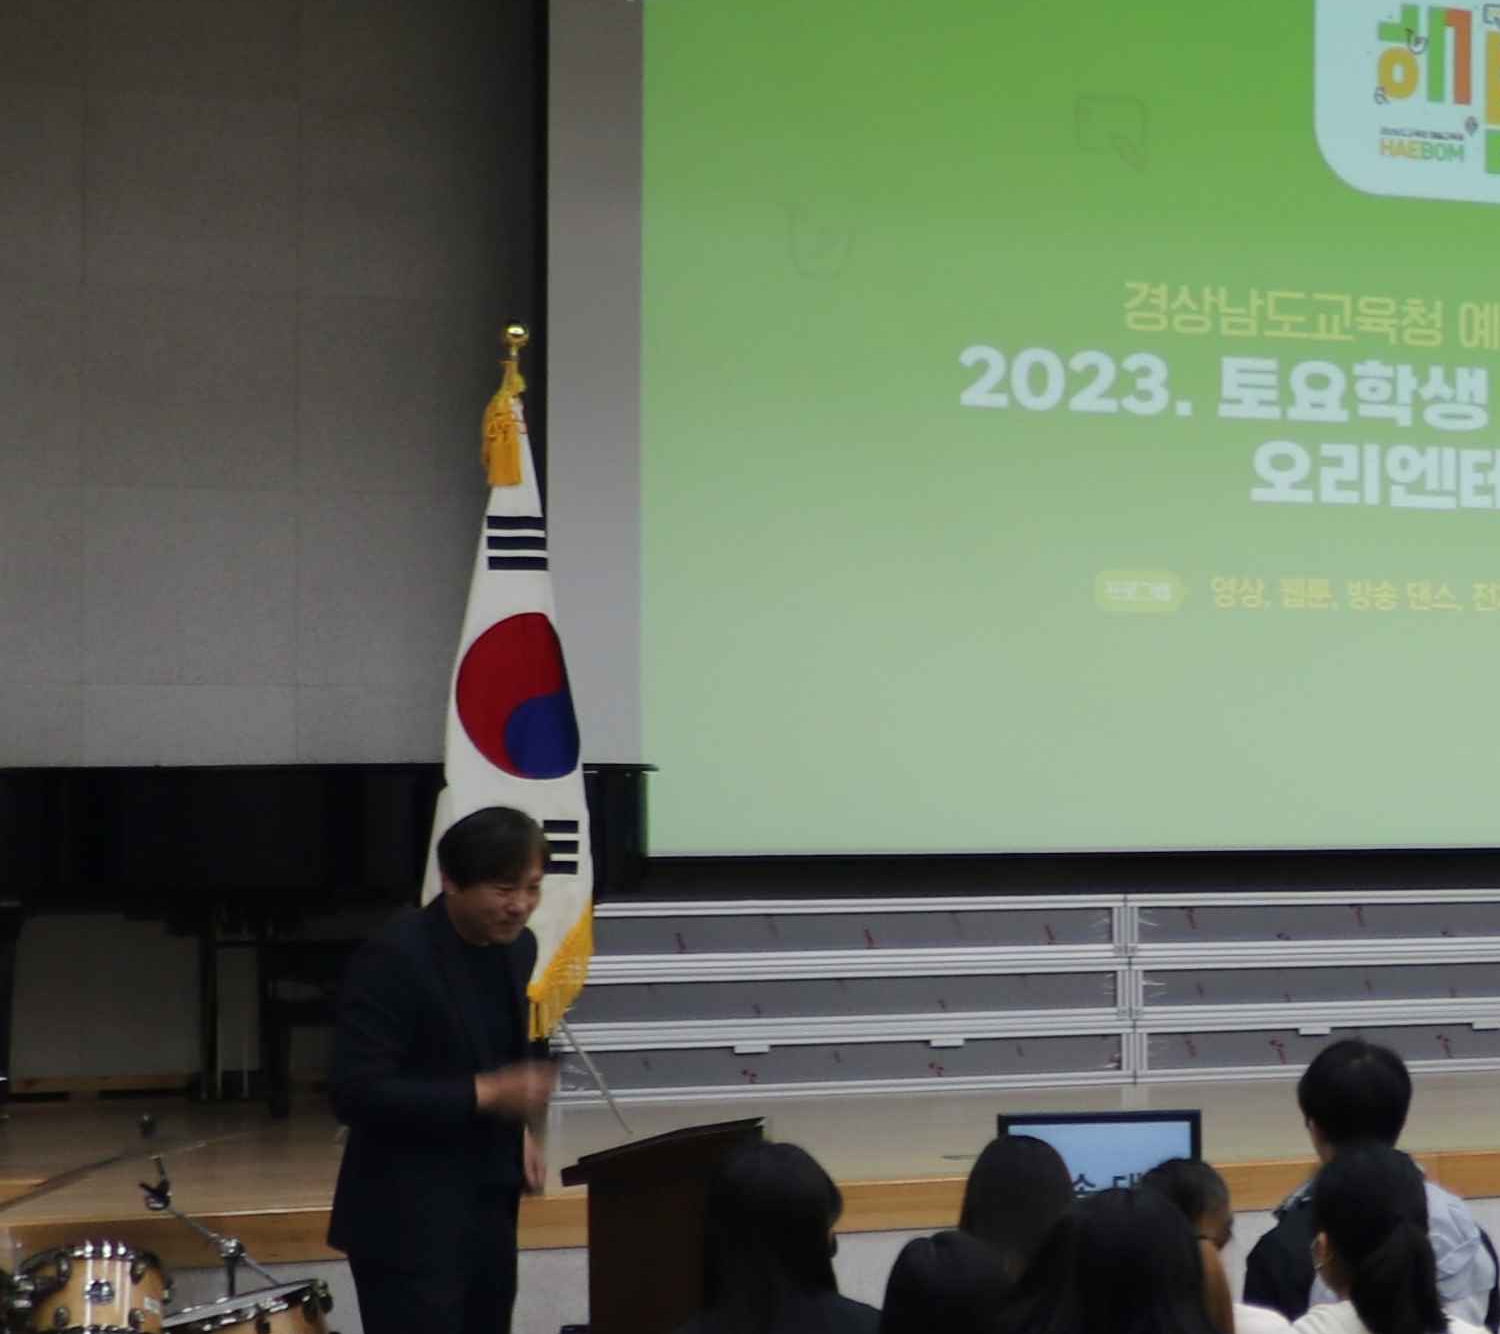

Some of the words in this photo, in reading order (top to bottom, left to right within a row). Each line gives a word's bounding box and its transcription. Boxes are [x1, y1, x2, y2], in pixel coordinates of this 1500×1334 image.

[1380, 138, 1465, 164] HAEBOM
[1122, 280, 1445, 348] 경상남도교육청
[958, 343, 1193, 418] 2023.
[1216, 354, 1490, 432] 토요학생
[1211, 576, 1272, 612] 영상,
[1347, 577, 1399, 612] 방송
[1406, 578, 1463, 613] 댄스,
